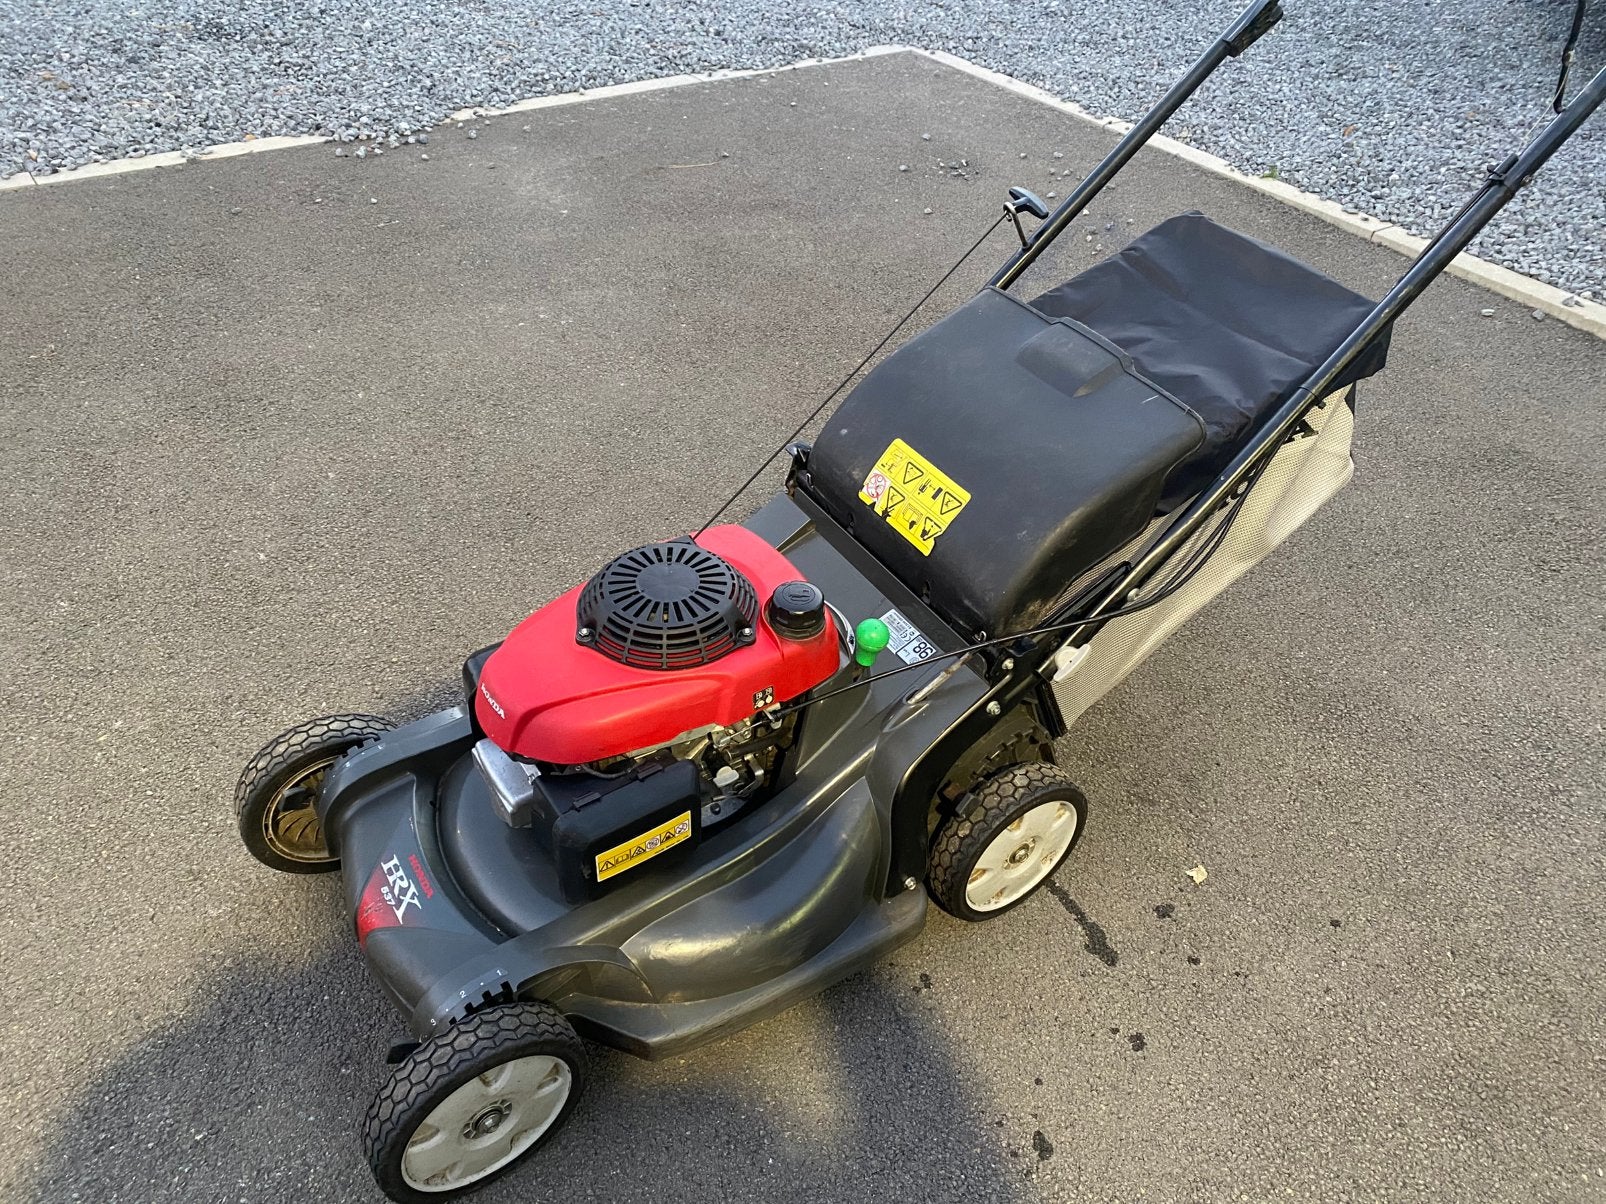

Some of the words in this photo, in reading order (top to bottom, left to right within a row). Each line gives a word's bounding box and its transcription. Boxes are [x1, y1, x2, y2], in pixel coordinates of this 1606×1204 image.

[912, 641, 934, 659] 98
[480, 682, 506, 720] HONDA
[380, 853, 422, 925] HRX
[408, 853, 435, 899] HONDA
[380, 885, 397, 906] 537
[459, 990, 467, 999] 2
